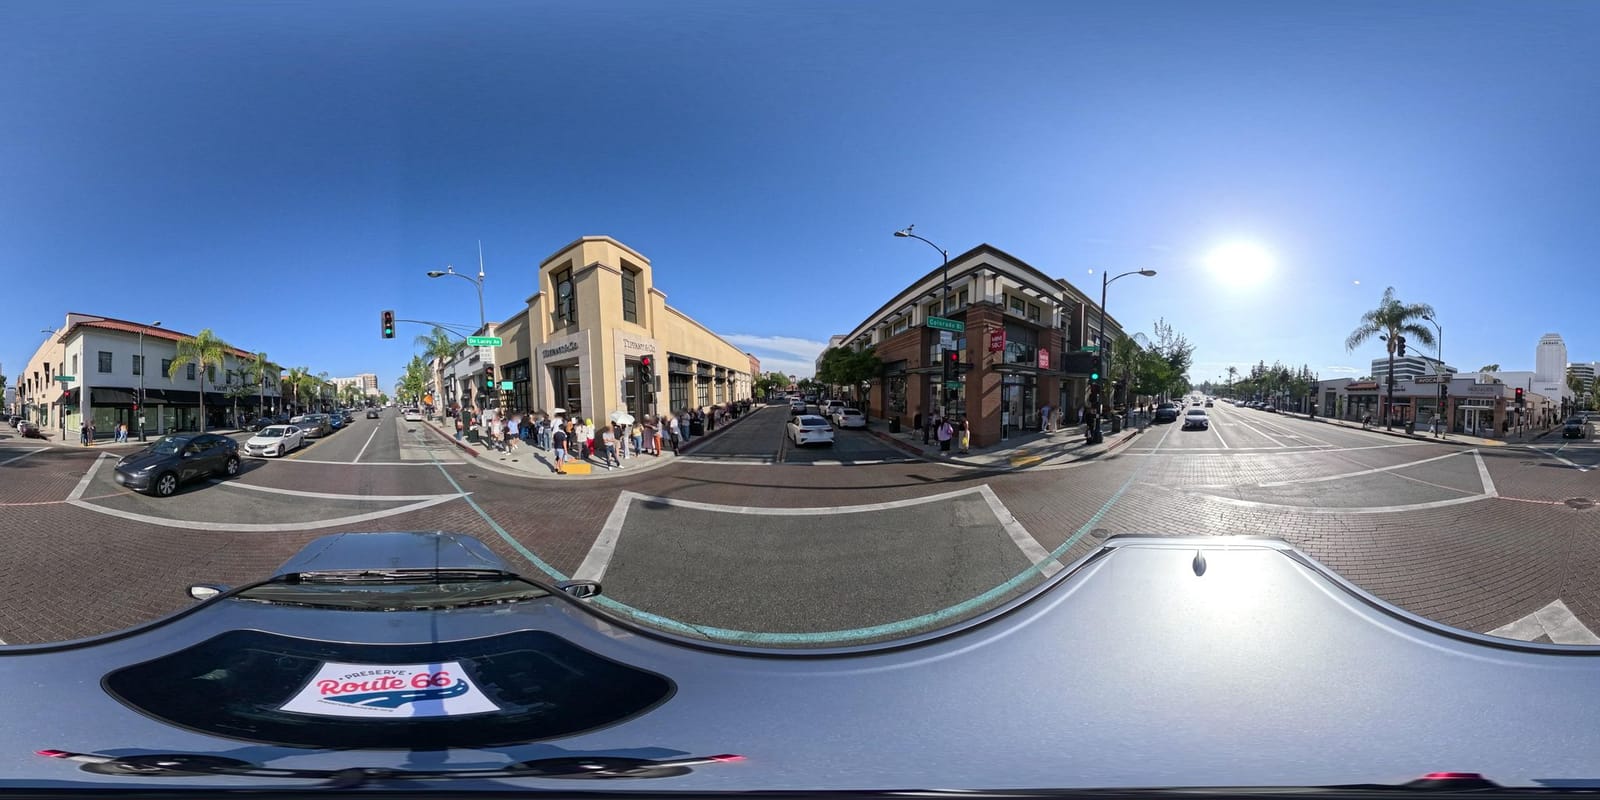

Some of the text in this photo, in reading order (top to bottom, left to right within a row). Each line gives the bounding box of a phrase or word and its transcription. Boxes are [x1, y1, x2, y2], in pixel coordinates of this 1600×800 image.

[345, 669, 406, 679] PRESERVE
[316, 671, 451, 695] Route 66
